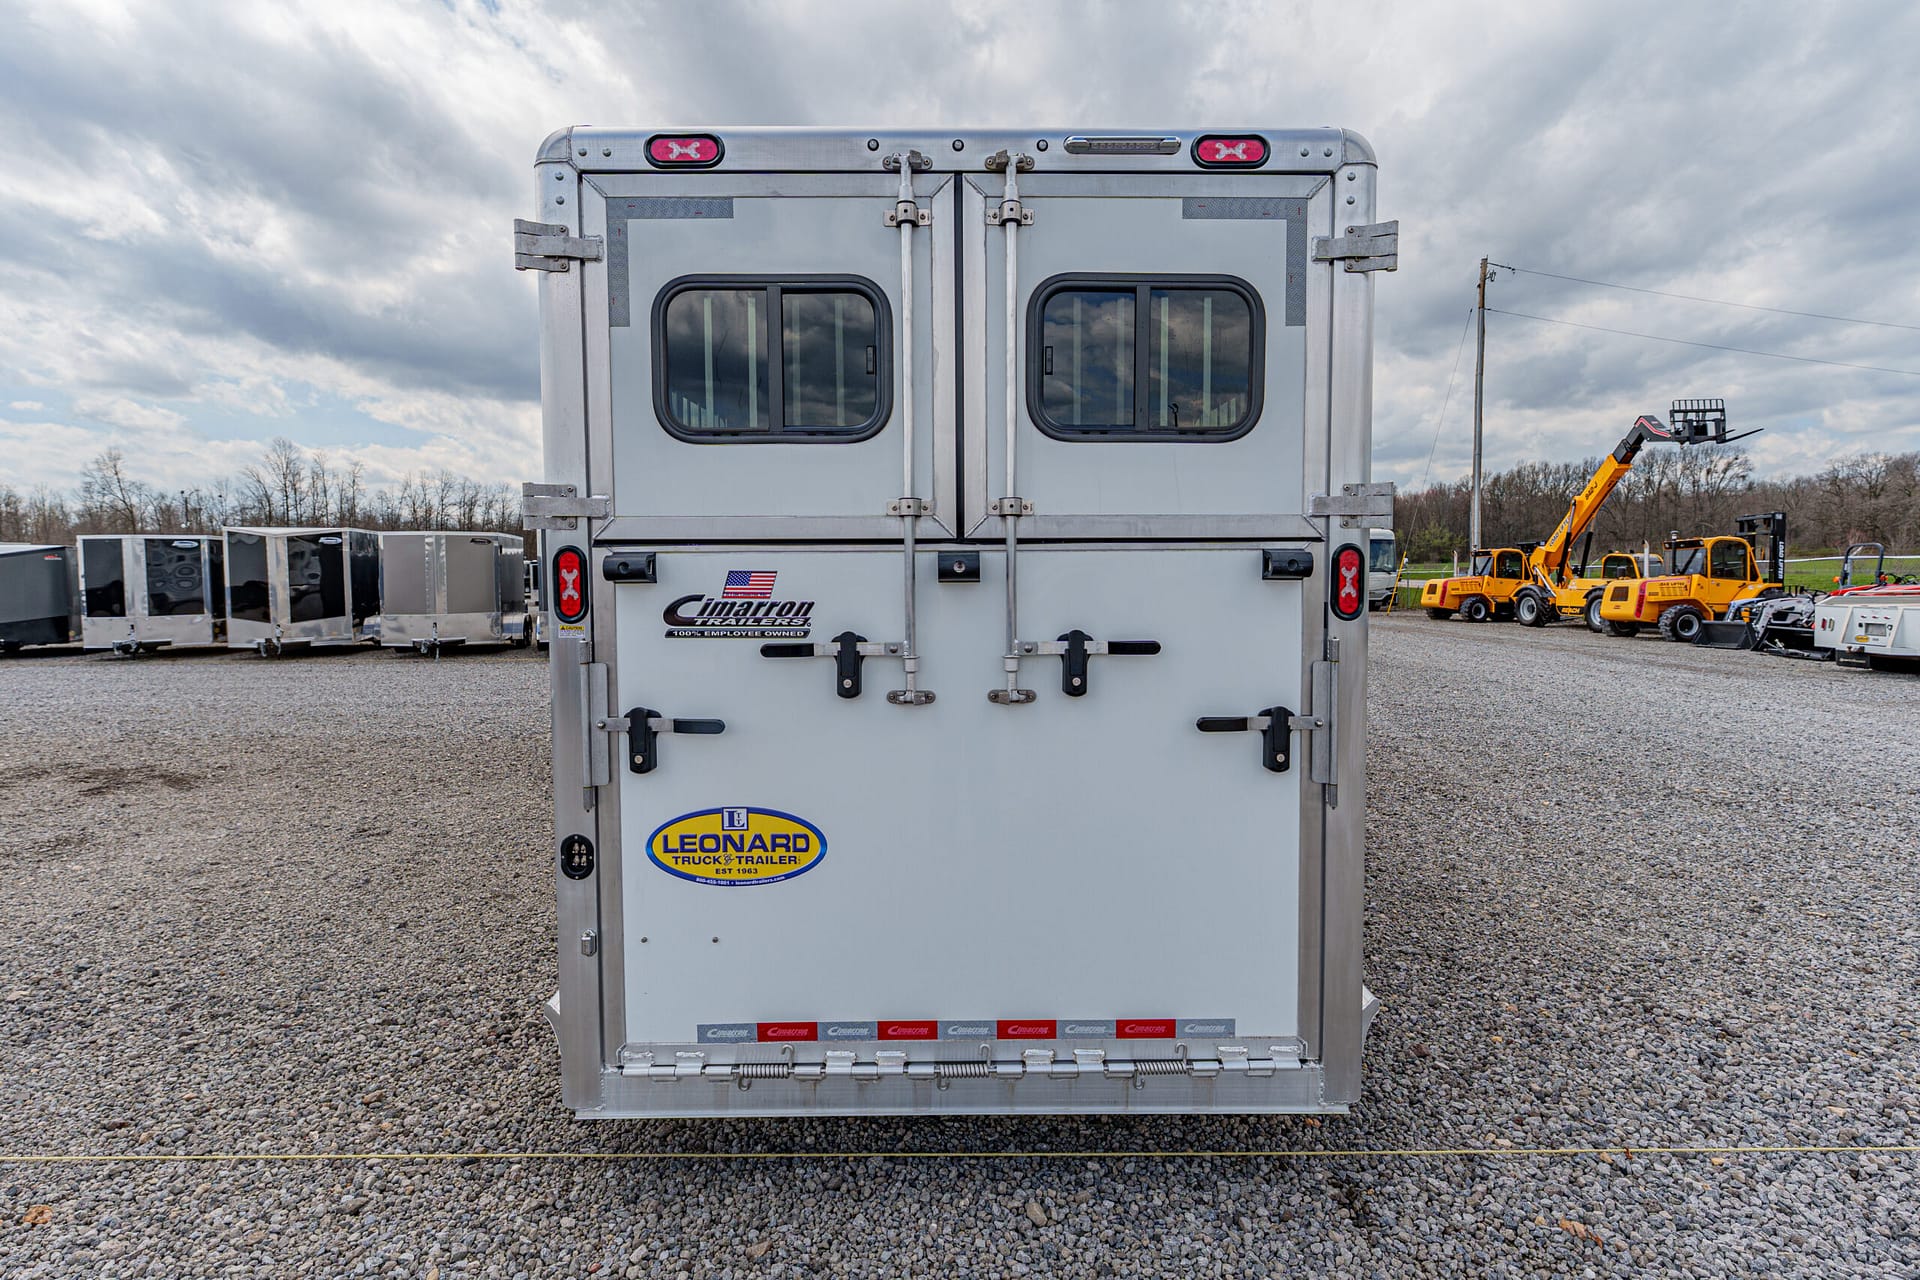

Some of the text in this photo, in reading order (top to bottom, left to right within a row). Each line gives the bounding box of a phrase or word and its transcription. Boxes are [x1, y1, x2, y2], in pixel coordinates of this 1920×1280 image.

[663, 594, 815, 626] Cimarron
[693, 618, 805, 626] TRAILERS
[662, 833, 811, 853] LEONARD
[672, 855, 722, 865] TRUCK
[735, 855, 797, 865] TRAILER
